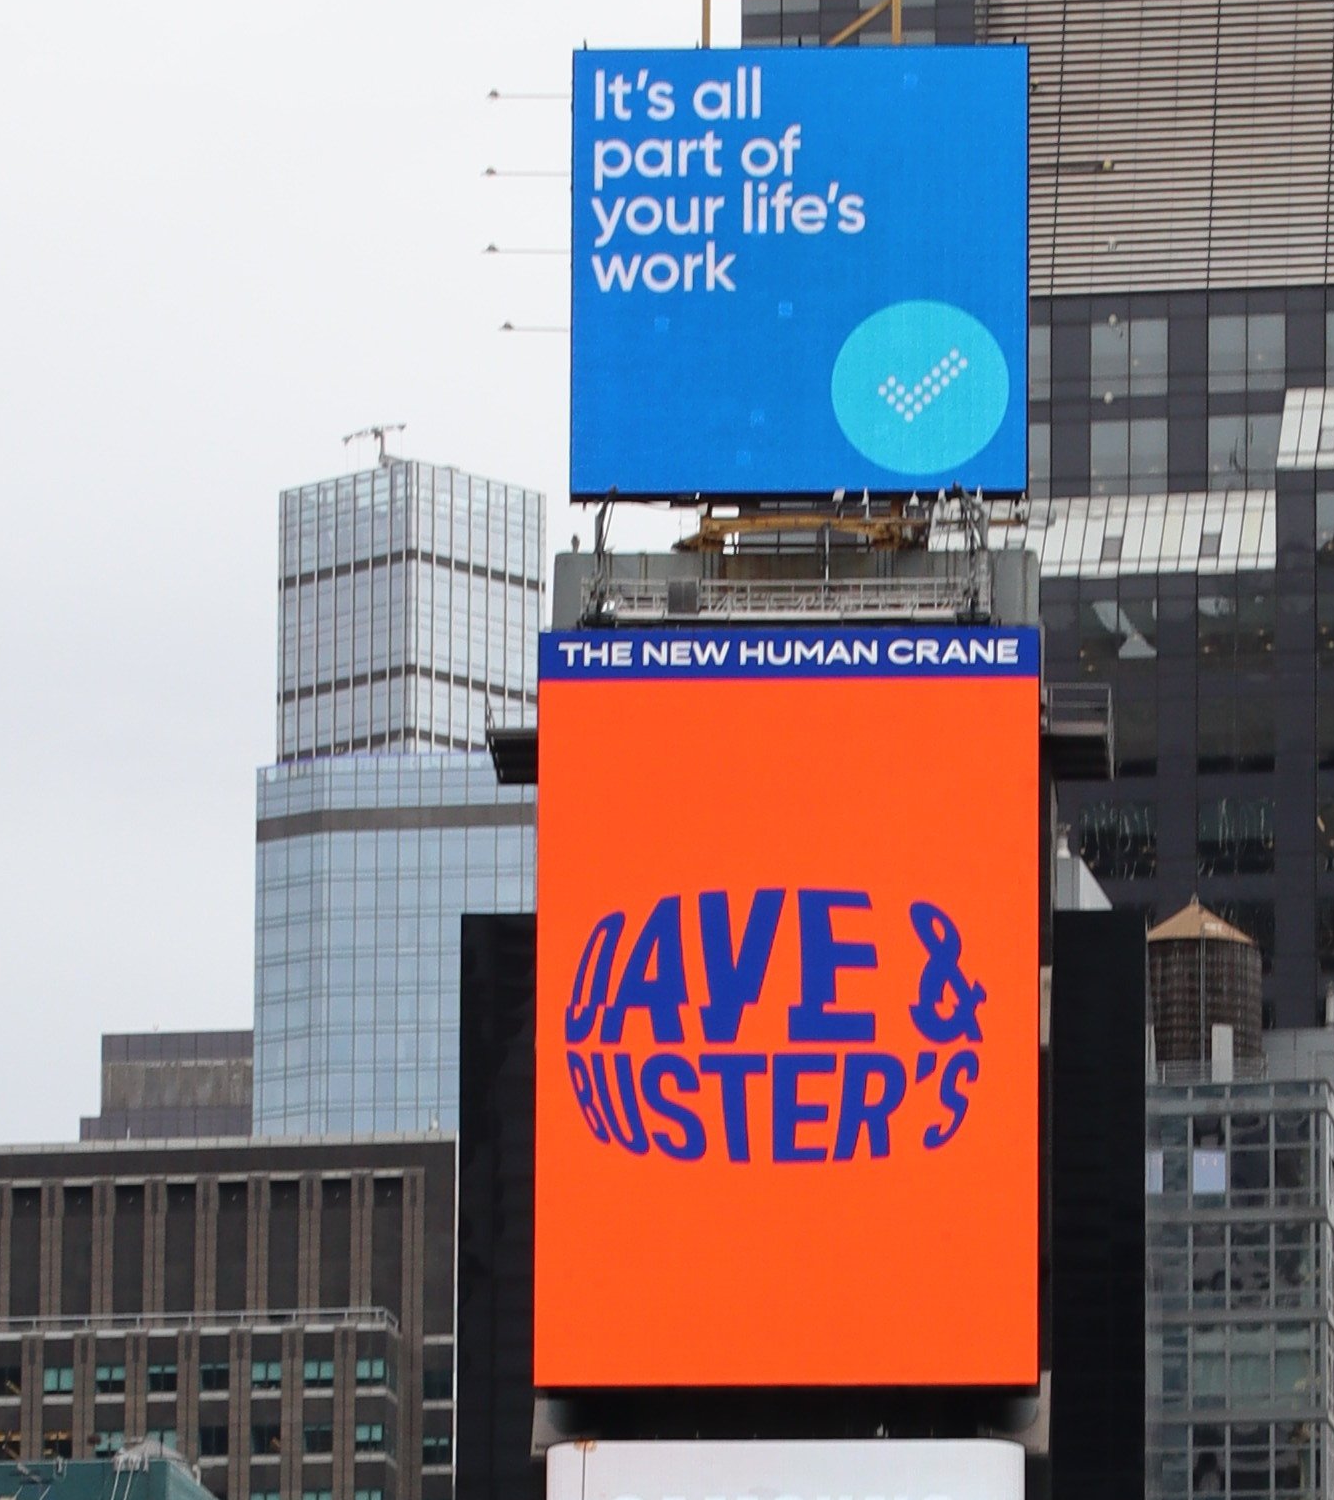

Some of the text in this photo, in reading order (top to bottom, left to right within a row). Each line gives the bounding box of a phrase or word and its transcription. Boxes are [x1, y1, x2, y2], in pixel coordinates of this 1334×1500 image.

[594, 67, 762, 119] It's all
[594, 125, 802, 188] part of
[592, 182, 866, 247] your life's
[591, 242, 737, 292] work
[558, 638, 1019, 667] THE NEW HUMAN CRANE
[565, 888, 987, 1044] DAVE &
[566, 1049, 980, 1164] BUSTER'S
